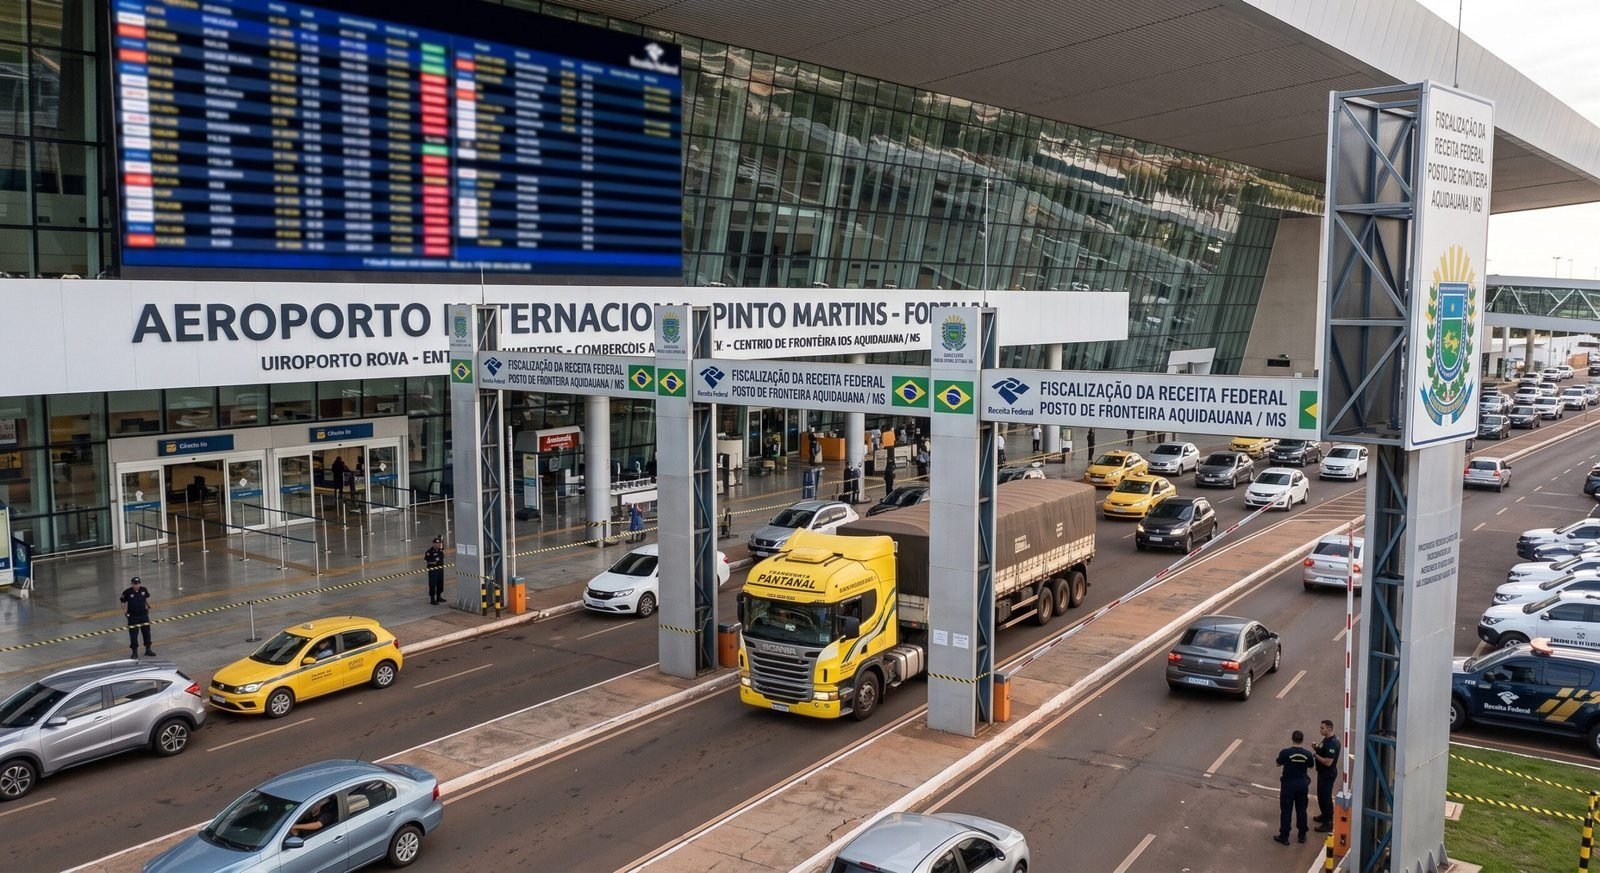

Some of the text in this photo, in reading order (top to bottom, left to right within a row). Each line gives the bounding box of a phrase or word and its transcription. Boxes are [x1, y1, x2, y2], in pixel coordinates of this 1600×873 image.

[1435, 110, 1486, 140] FISCALIZAÇÃO DA
[1434, 137, 1484, 164] RECEITA FEDERAL
[1428, 162, 1488, 189] POSTO DE FRONTEIRA
[1431, 190, 1469, 210] AQUIDAUANA
[131, 302, 431, 344] AEROPORTO
[713, 302, 785, 329] PINTO
[793, 301, 888, 328] MARTINS
[261, 352, 363, 371] UIROPORTO
[366, 351, 409, 367] ROVA
[733, 338, 773, 350] CENTRIO
[775, 338, 787, 349] DE
[854, 333, 904, 347] AQUIDAUANA
[508, 358, 624, 376] FISCALIZAÇÃO DA RECEITA FEDERAL
[508, 374, 526, 385] POSTO
[528, 375, 536, 385] DE
[537, 375, 568, 388] FRONTEIRA
[570, 377, 609, 389] AQUIDAUANA
[614, 379, 624, 390] MS
[732, 369, 885, 389] FISCALIZAÇÃO DA RECEITA FEDERAL
[732, 386, 756, 398] POSTO
[757, 387, 767, 399] DE
[769, 388, 811, 401] FRONTEIRA
[813, 390, 865, 404] AQUIDAUANA
[872, 393, 885, 405] MS
[1040, 379, 1288, 406] FISCALIZAÇÃO DA RECEITA FEDERAL
[988, 406, 1034, 416] Receita Federal
[1039, 401, 1077, 417] POSTO
[1080, 403, 1096, 418] DE
[1099, 404, 1166, 421] FRONTEIRA
[1168, 407, 1253, 426] AQUIDAUANA
[1266, 412, 1287, 428] MS
[757, 574, 816, 589] PANTANAL
[762, 644, 797, 655] SCANIA
[1507, 705, 1531, 714] Federal
